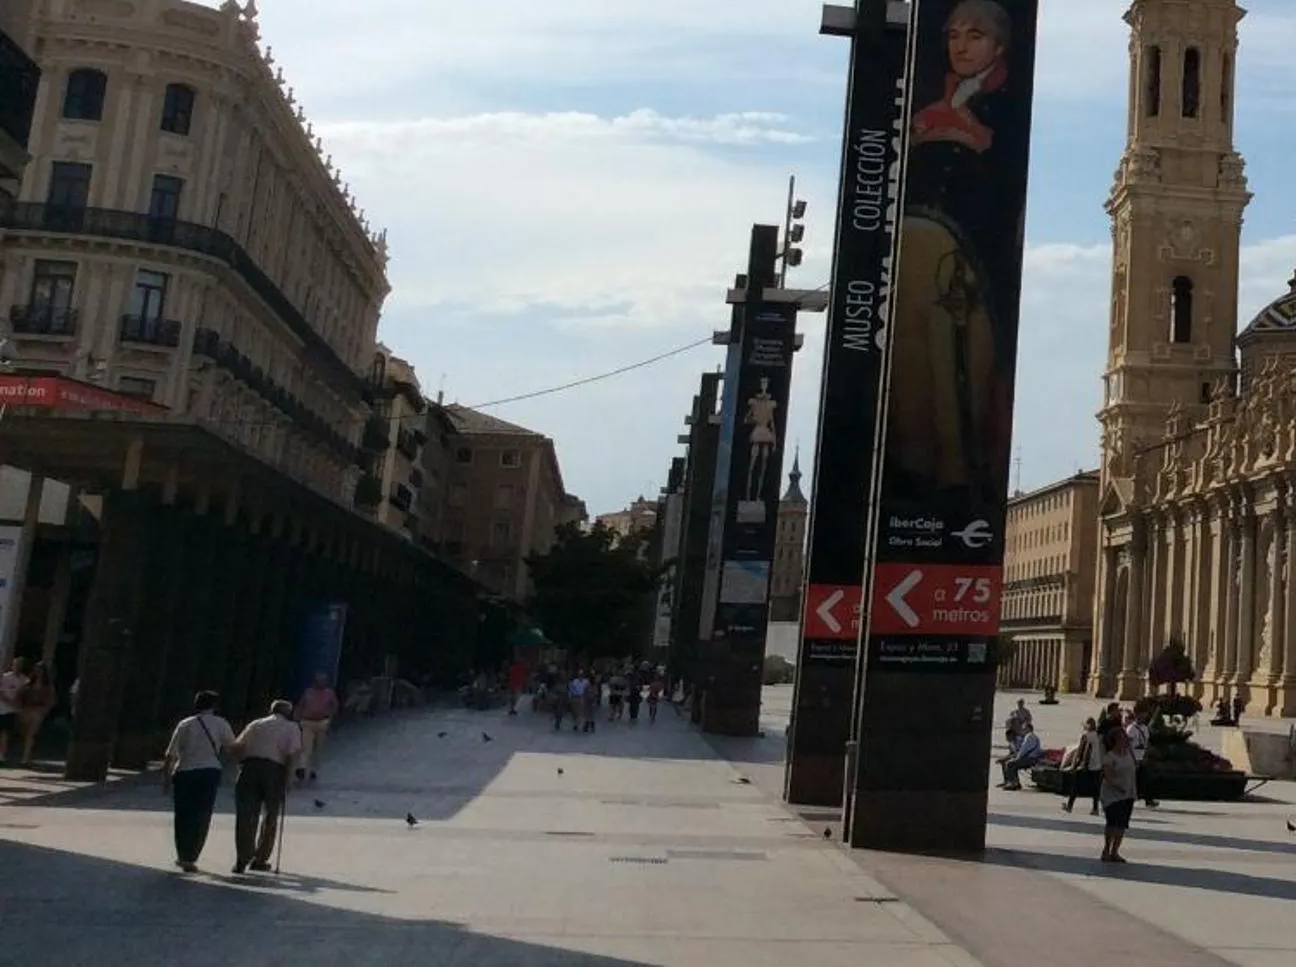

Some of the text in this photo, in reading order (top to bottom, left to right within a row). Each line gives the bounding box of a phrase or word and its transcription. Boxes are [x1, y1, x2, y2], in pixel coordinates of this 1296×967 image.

[852, 127, 889, 233] COLECCIÓN
[842, 278, 875, 352] MUSEO
[933, 607, 990, 622] metros
[934, 577, 991, 603] a 75
